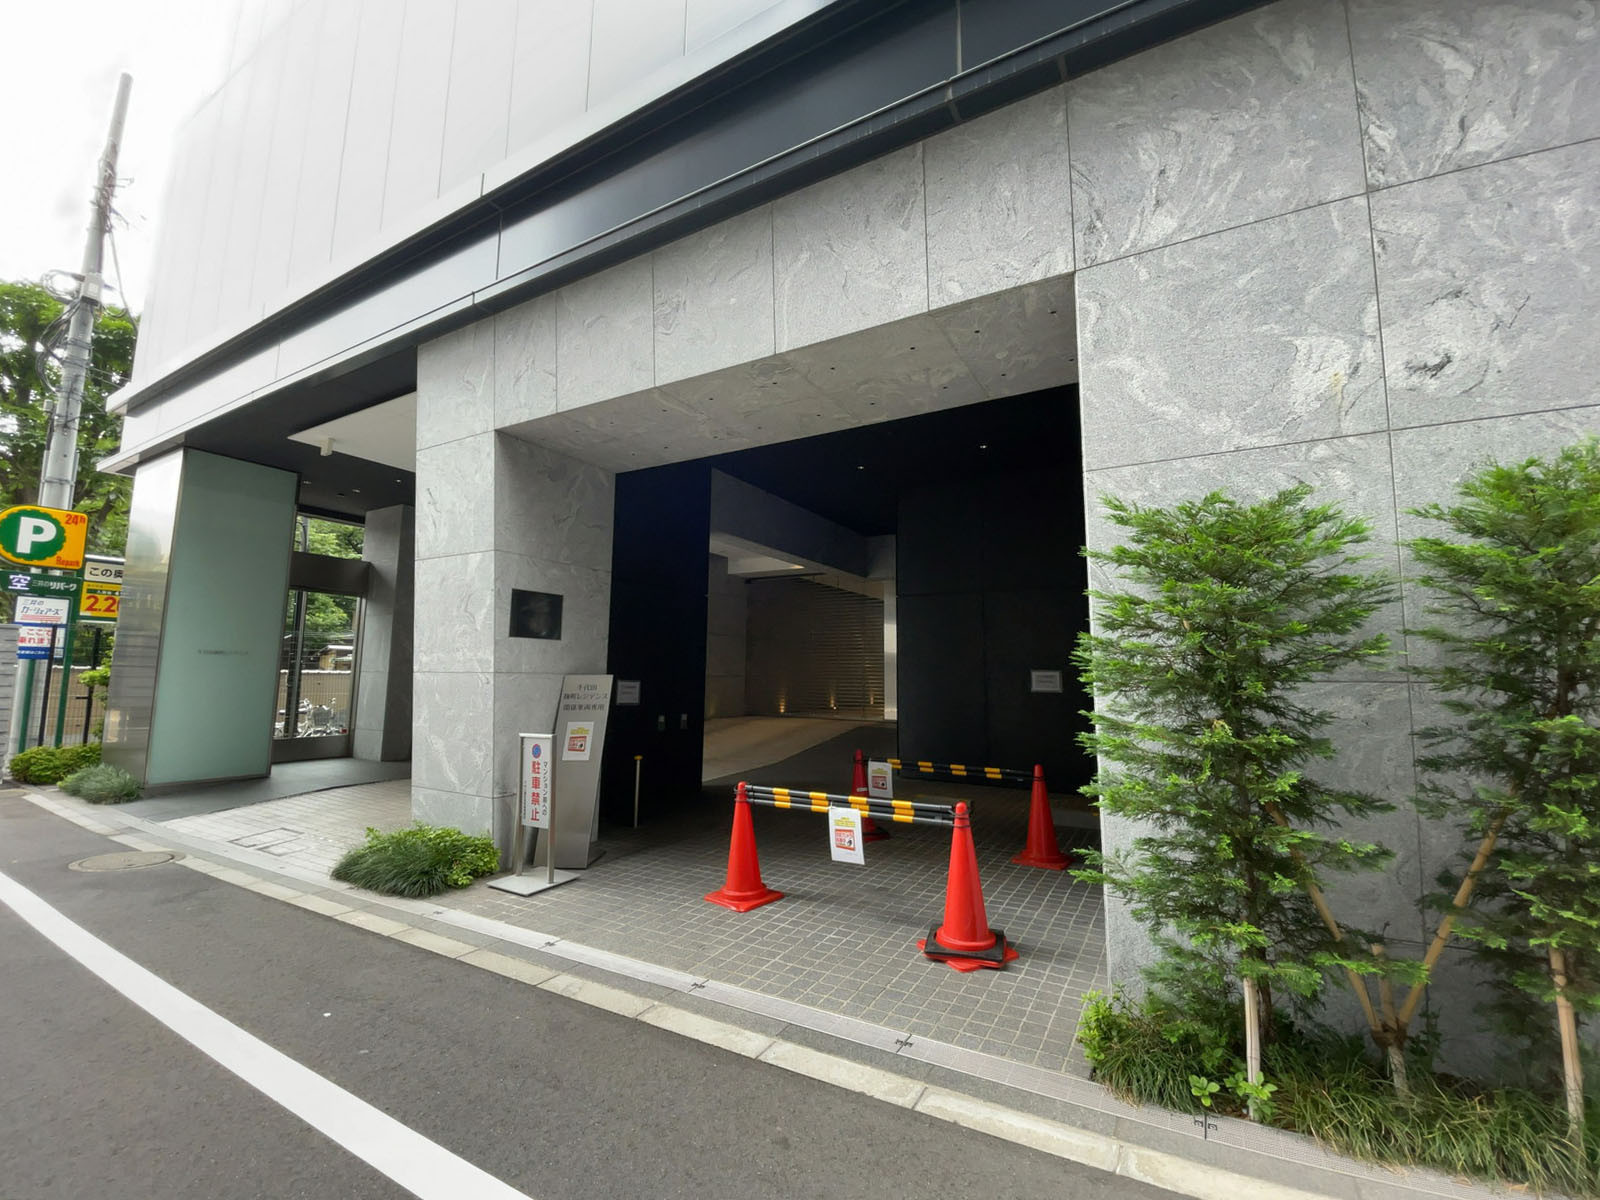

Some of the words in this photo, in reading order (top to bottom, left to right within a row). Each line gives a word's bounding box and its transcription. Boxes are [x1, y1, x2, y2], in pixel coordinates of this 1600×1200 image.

[65, 514, 86, 526] 24h
[16, 516, 57, 554] P
[8, 574, 31, 590] 空
[530, 760, 541, 822] 駐車禁止
